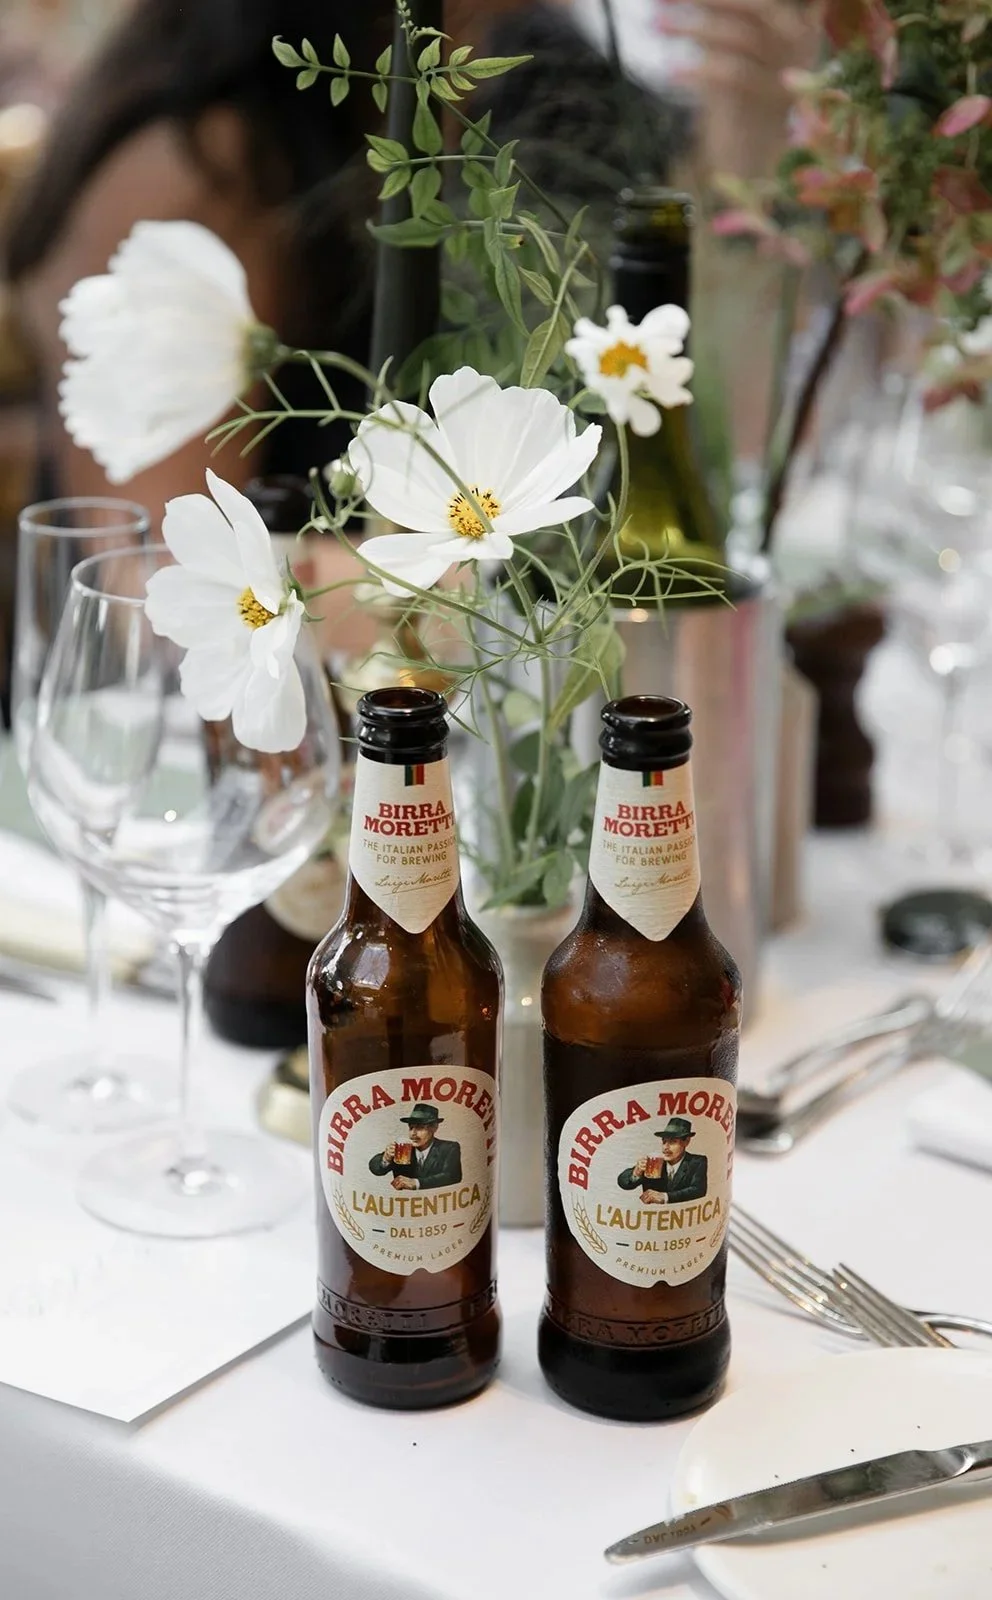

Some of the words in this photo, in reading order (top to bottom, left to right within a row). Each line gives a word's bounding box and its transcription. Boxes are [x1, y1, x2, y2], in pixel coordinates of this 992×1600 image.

[379, 800, 446, 820] BIRRA
[617, 800, 686, 822] BIRRA
[363, 839, 378, 851] THE
[382, 843, 424, 855] ITALIAN
[602, 839, 618, 852] THE
[621, 844, 663, 856] ITALIAN
[376, 853, 397, 866] FOR
[401, 850, 448, 867] BREWING
[615, 855, 636, 867] FOR
[640, 850, 687, 868] BREWING
[327, 1084, 396, 1176] BIRRA
[568, 1099, 651, 1190] BIRRA
[352, 1183, 482, 1218] L'AUTENTICA
[596, 1196, 721, 1231] L'AUTENTICA
[390, 1227, 415, 1239] DAL
[419, 1223, 448, 1238] 1859
[372, 1243, 424, 1262] PREMIUM
[430, 1237, 464, 1260] LAGER
[634, 1240, 660, 1252] DAL
[664, 1237, 692, 1251] 1859
[615, 1256, 667, 1276] PREMIUM
[673, 1252, 705, 1273] LAGER
